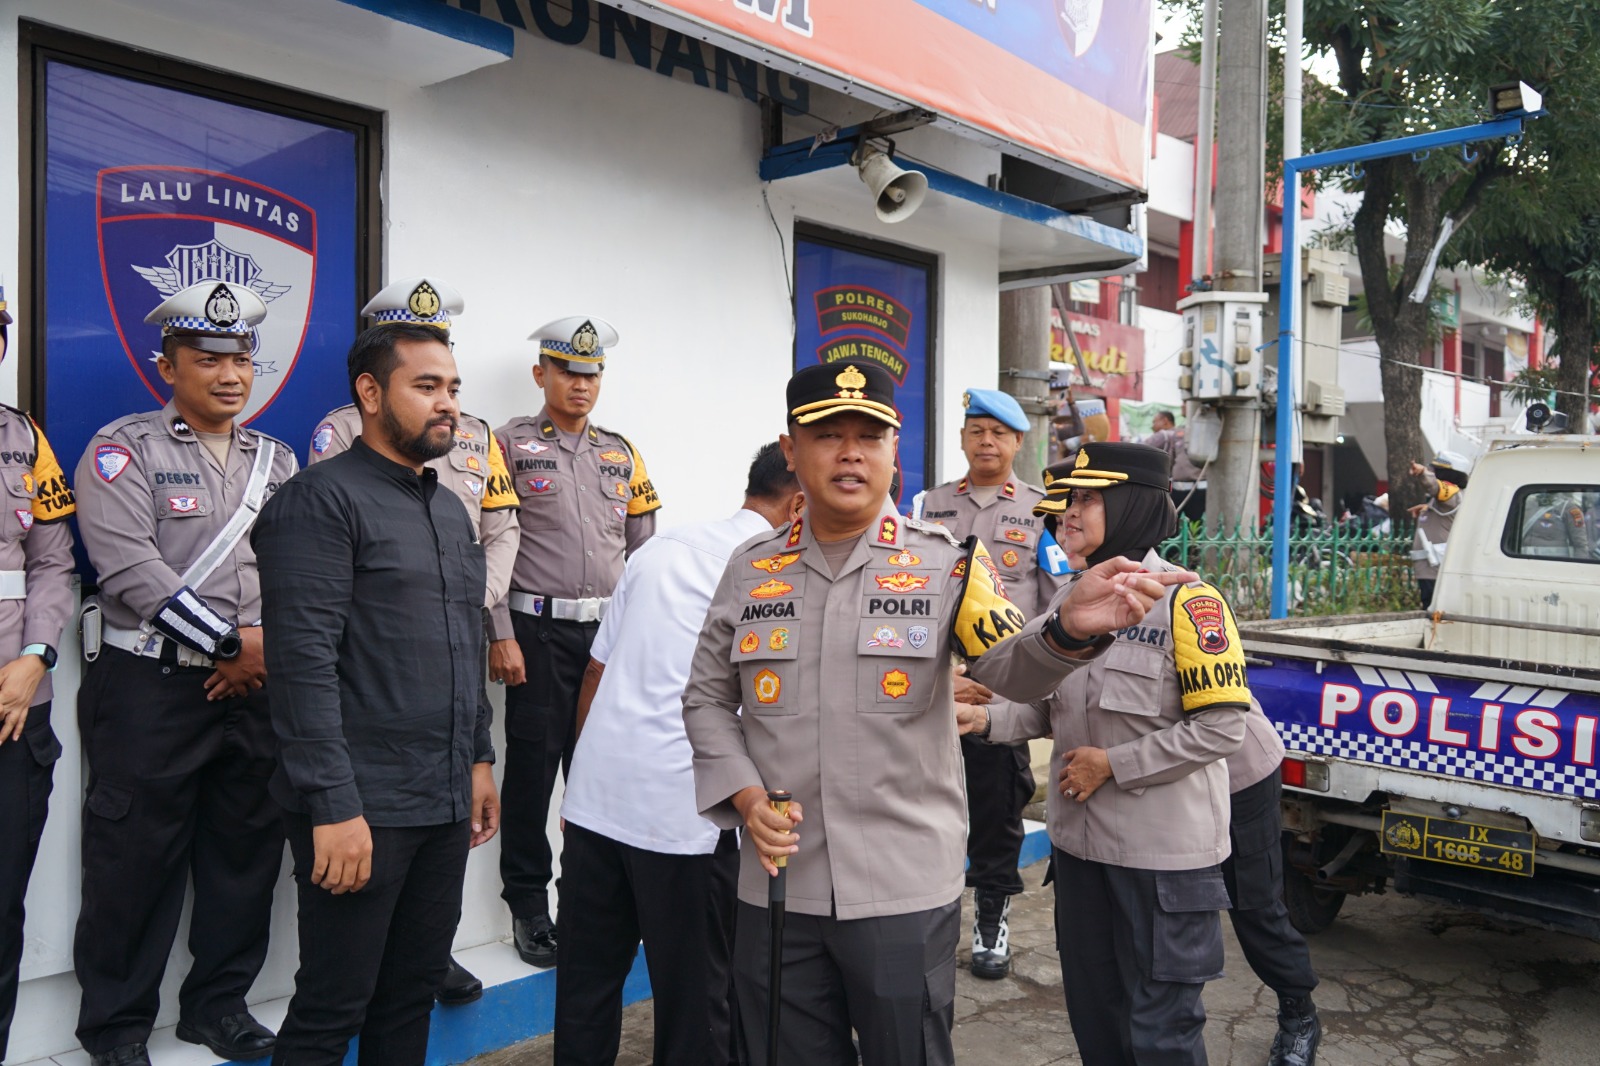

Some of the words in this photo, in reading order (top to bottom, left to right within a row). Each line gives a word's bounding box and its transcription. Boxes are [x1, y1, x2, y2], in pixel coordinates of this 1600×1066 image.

[121, 182, 192, 203] LALU
[207, 185, 300, 232] LINTAS
[835, 292, 894, 315] POLRES
[841, 312, 888, 328] SUKOHARJO
[826, 343, 858, 363] JAWA
[860, 343, 903, 375] TENGAH
[515, 459, 558, 471] WAHYUDI
[155, 471, 200, 485] DEBBY
[1001, 514, 1035, 528] POLRI
[740, 601, 795, 622] ANGGA
[869, 598, 931, 616] POLRI
[1191, 601, 1218, 609] POLRES
[1117, 627, 1167, 647] POLRI
[1214, 662, 1242, 688] OPS
[1320, 681, 1599, 766] POLISI
[1469, 826, 1489, 843] IX
[1433, 840, 1481, 864] 1605
[1498, 851, 1524, 871] 48
